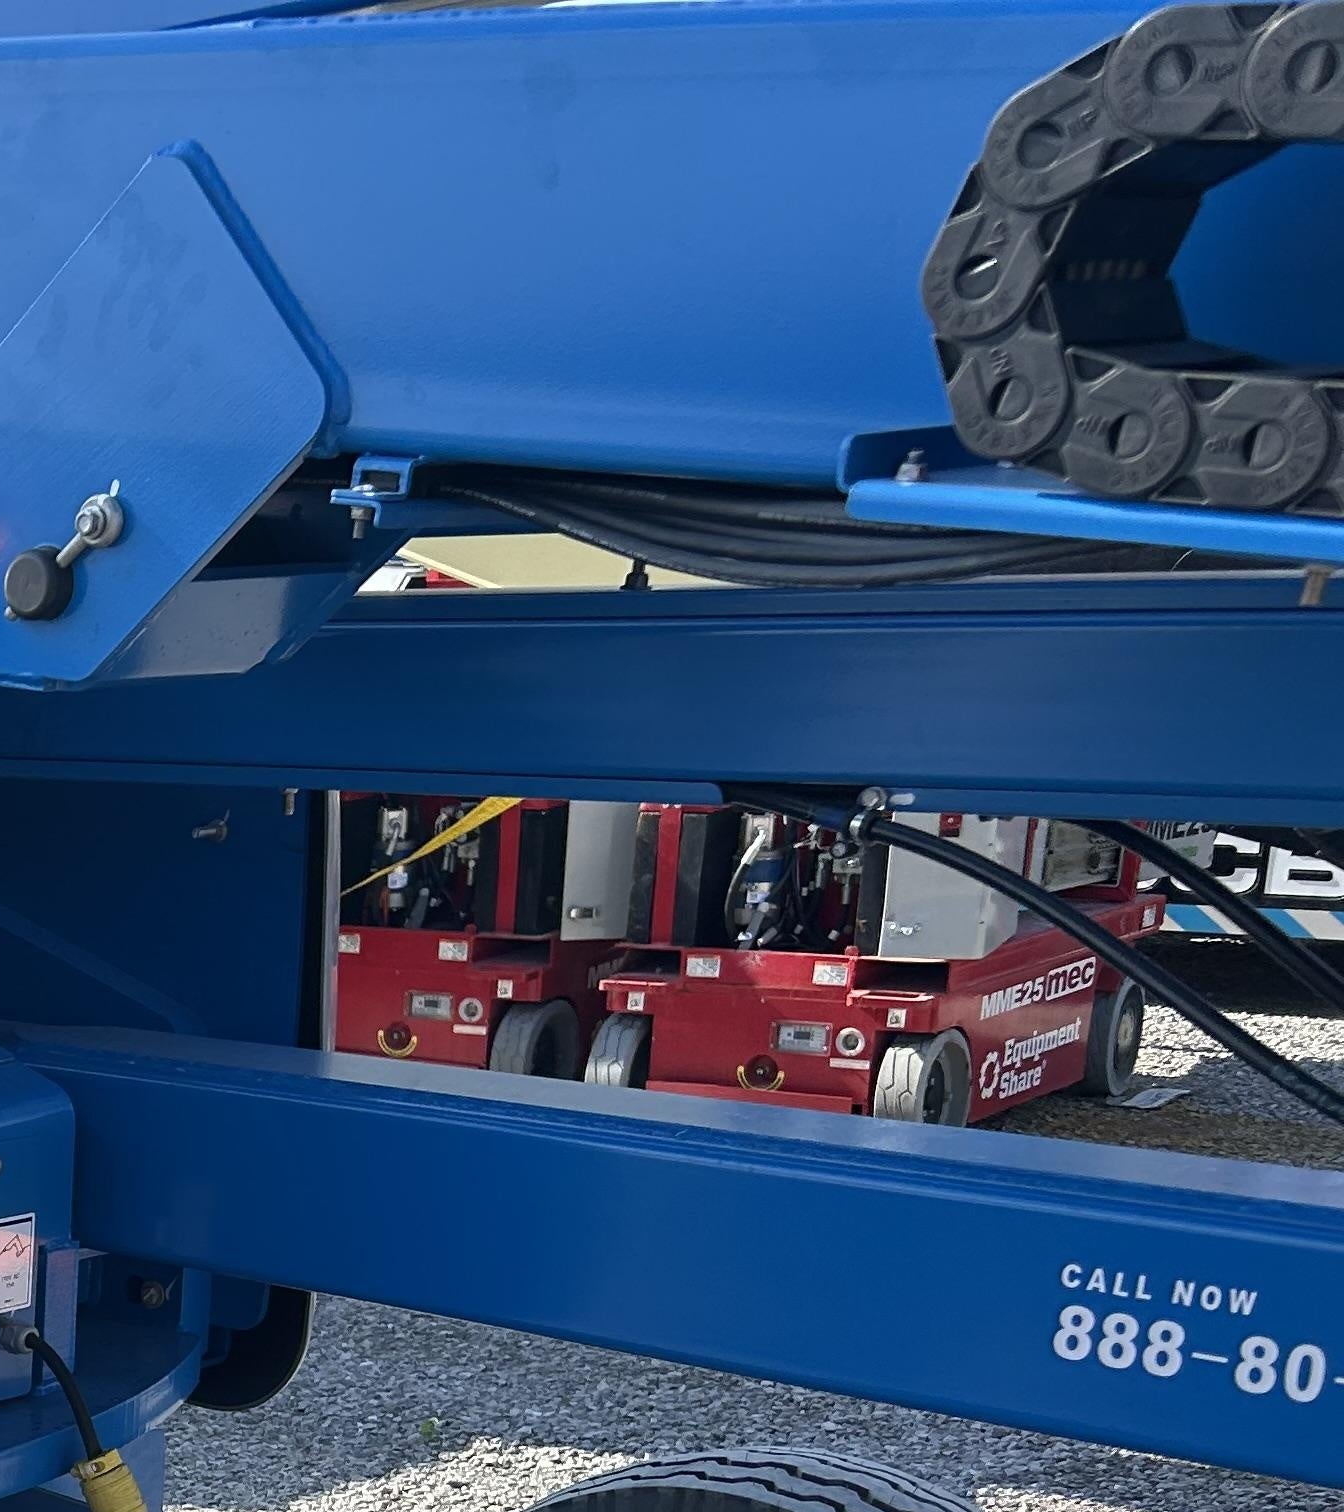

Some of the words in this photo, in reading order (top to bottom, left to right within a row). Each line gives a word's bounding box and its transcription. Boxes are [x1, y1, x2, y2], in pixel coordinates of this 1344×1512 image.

[979, 976, 1045, 1021] MME25
[1047, 961, 1095, 997] mec
[1002, 1017, 1082, 1070] Equipment
[1061, 1263, 1153, 1300] CALL
[1171, 1279, 1258, 1316] NOW
[1053, 1304, 1344, 1403] 888-80
